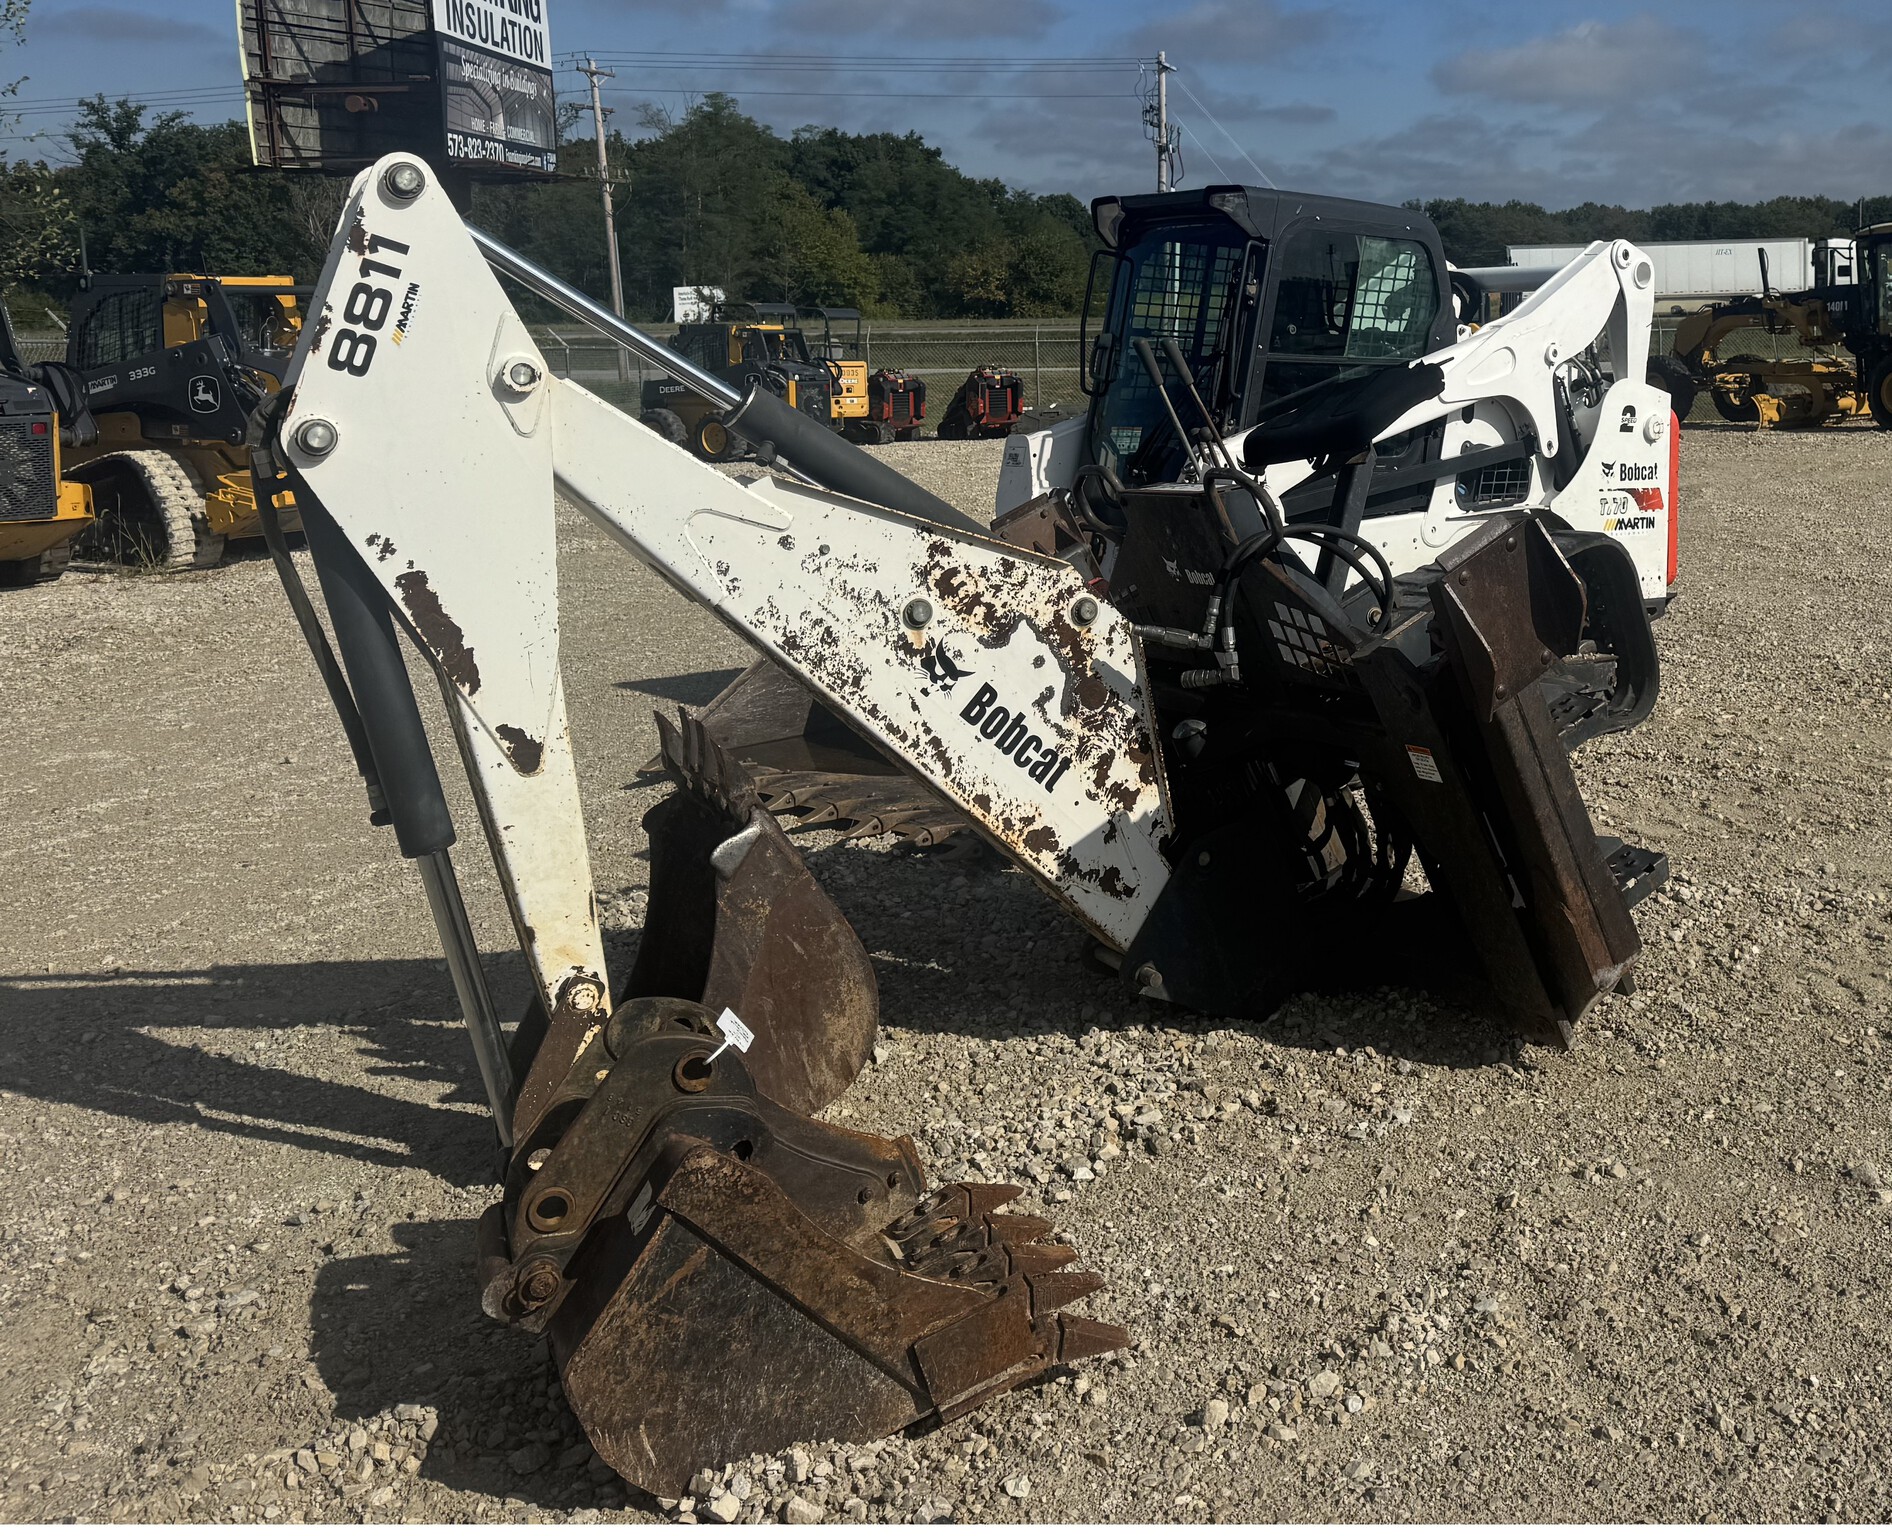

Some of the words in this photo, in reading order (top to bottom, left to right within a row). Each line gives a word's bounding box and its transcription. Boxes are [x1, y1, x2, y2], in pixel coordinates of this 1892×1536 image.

[446, 0, 544, 63] INSULATION
[461, 55, 500, 91] Specializing
[510, 70, 537, 99] Buildings
[447, 132, 505, 162] 573-823-2370
[327, 233, 410, 377] 8811
[395, 282, 420, 333] MARTIN
[128, 366, 156, 381] 333G
[659, 385, 685, 394] DEERE
[1619, 463, 1658, 481] Bobcat
[1614, 516, 1655, 532] MARTIN
[1185, 569, 1215, 586] Bobcat
[959, 681, 1073, 793] Bobcat
